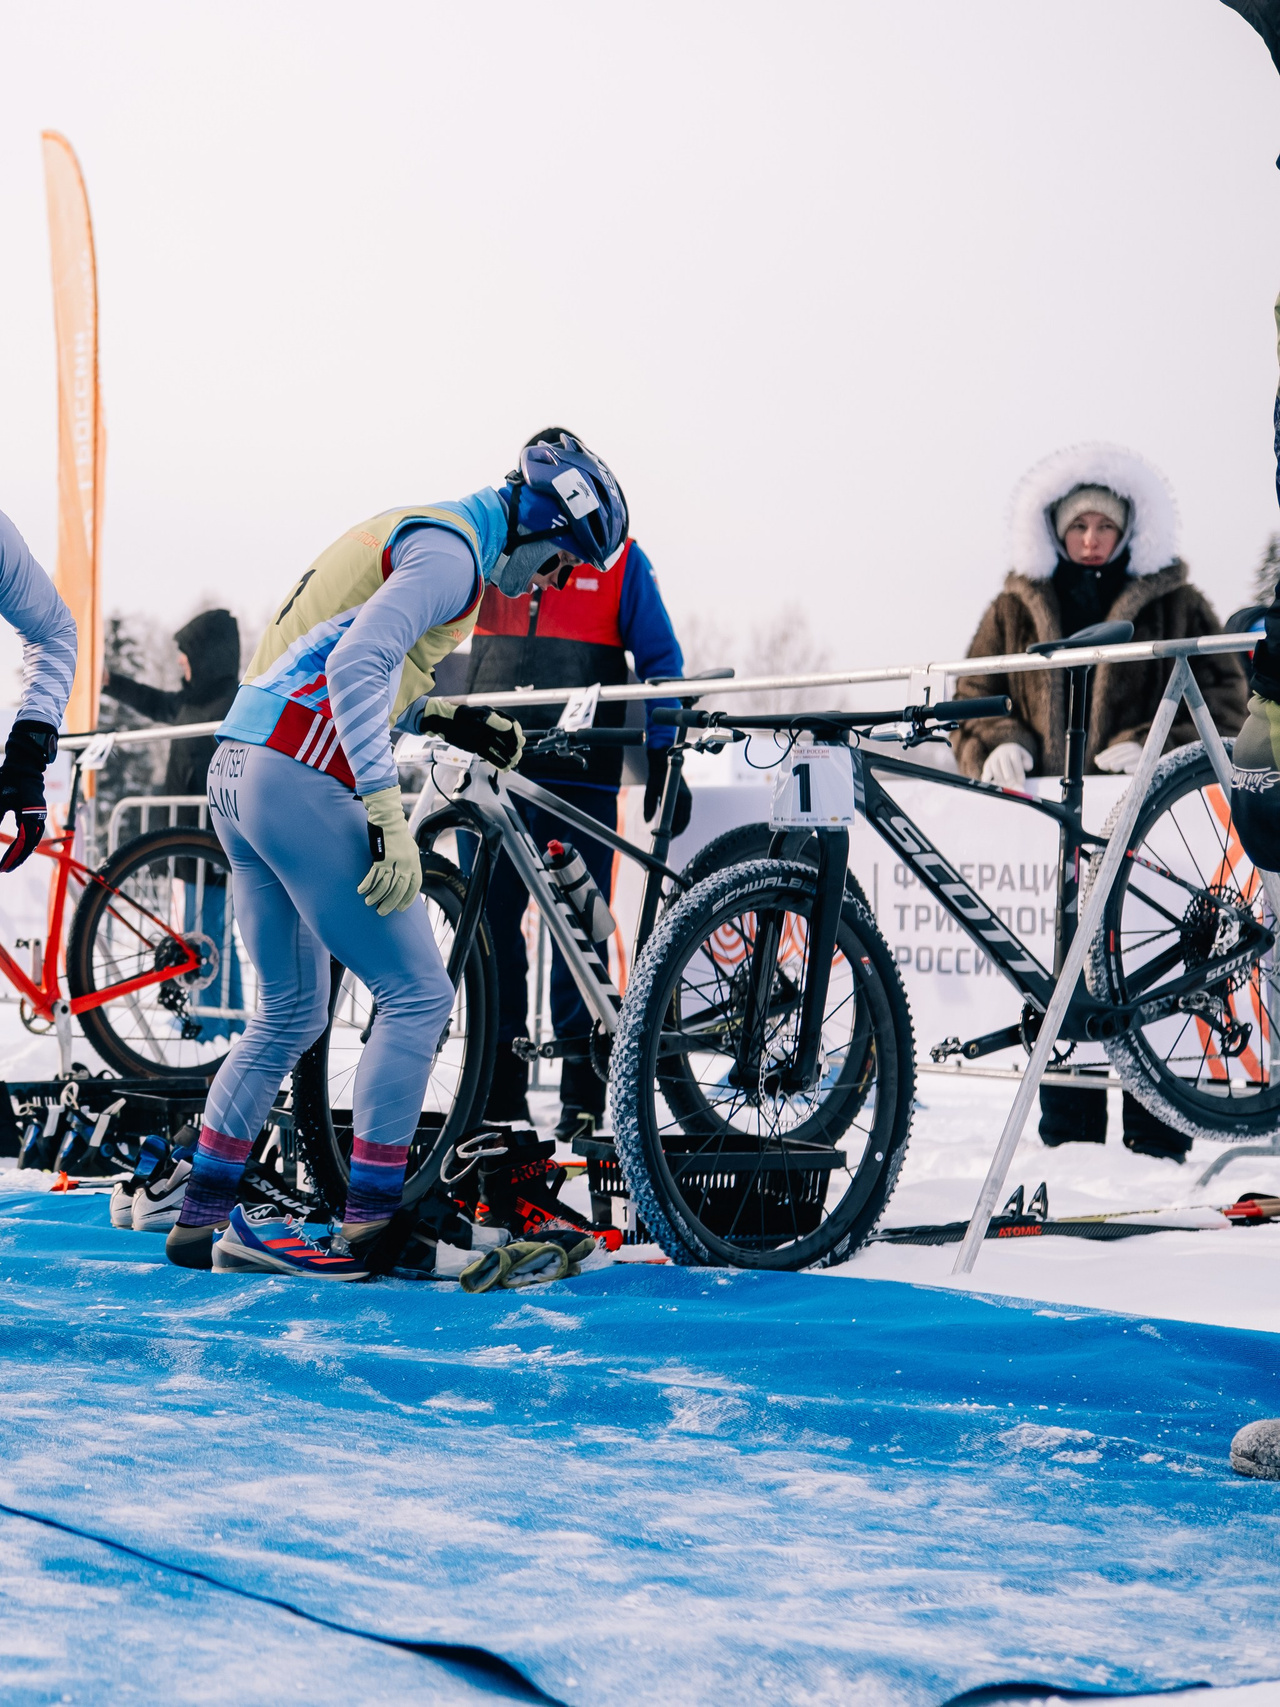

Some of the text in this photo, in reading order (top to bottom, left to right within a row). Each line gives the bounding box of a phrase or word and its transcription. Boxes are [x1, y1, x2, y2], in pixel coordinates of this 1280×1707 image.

[566, 489, 580, 502] 1
[276, 568, 317, 625] 1
[209, 786, 240, 822] AIN
[792, 763, 812, 812] 1
[712, 876, 815, 915] SCHWALBE
[894, 864, 1084, 895] ФЕРАЦИ
[876, 816, 1050, 981] SCOTT
[894, 905, 1057, 935] ТРИЛОН
[1205, 949, 1255, 983] SCOTT
[622, 1205, 628, 1222] 1
[998, 1225, 1042, 1237] ATOMIC
